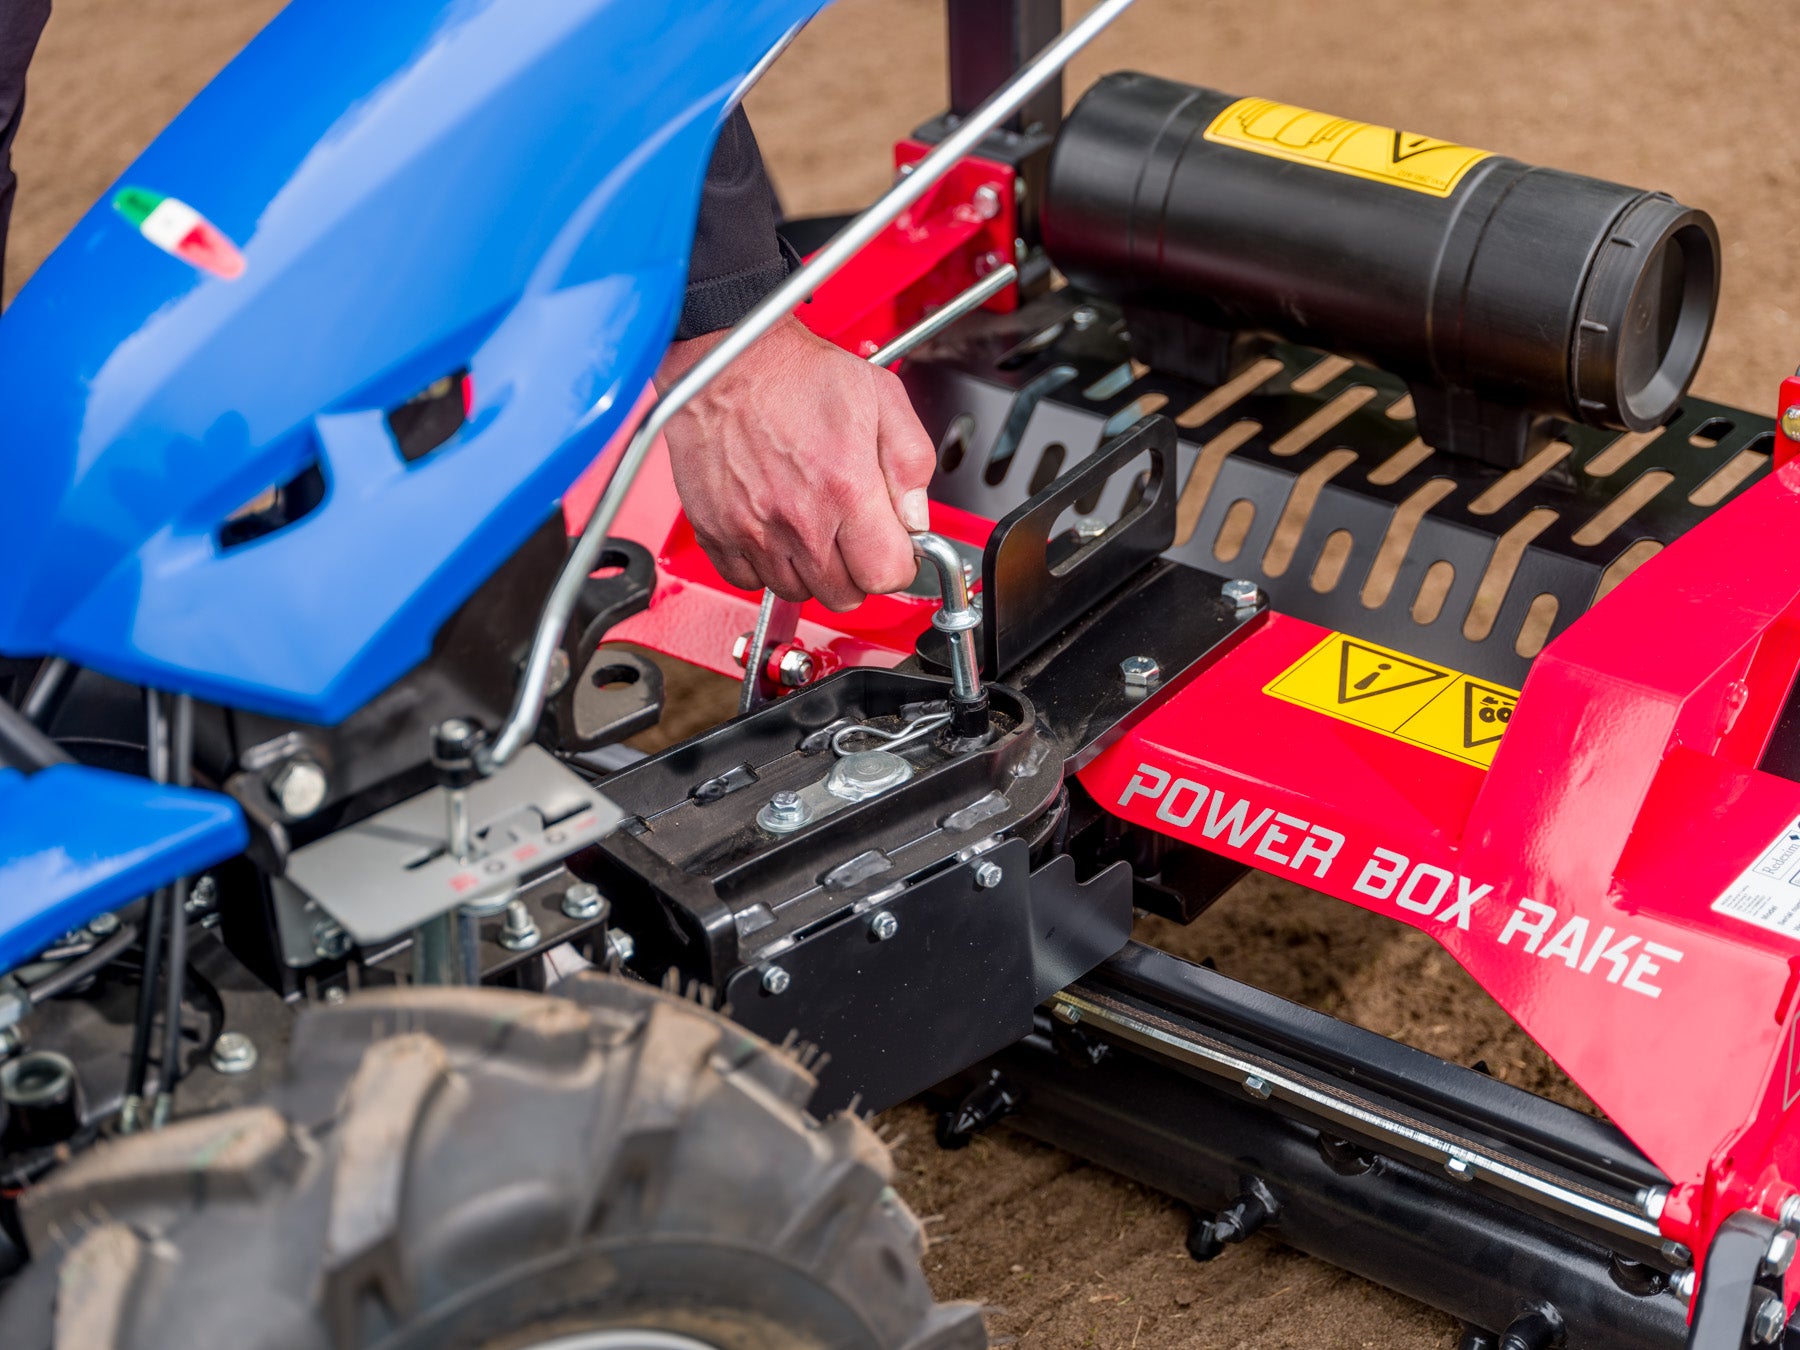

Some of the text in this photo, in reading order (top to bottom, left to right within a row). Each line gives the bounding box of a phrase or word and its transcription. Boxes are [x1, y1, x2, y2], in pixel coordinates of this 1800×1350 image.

[1117, 763, 1684, 999] POWER BOX RAKE
[1762, 843, 1799, 875] Redexim
